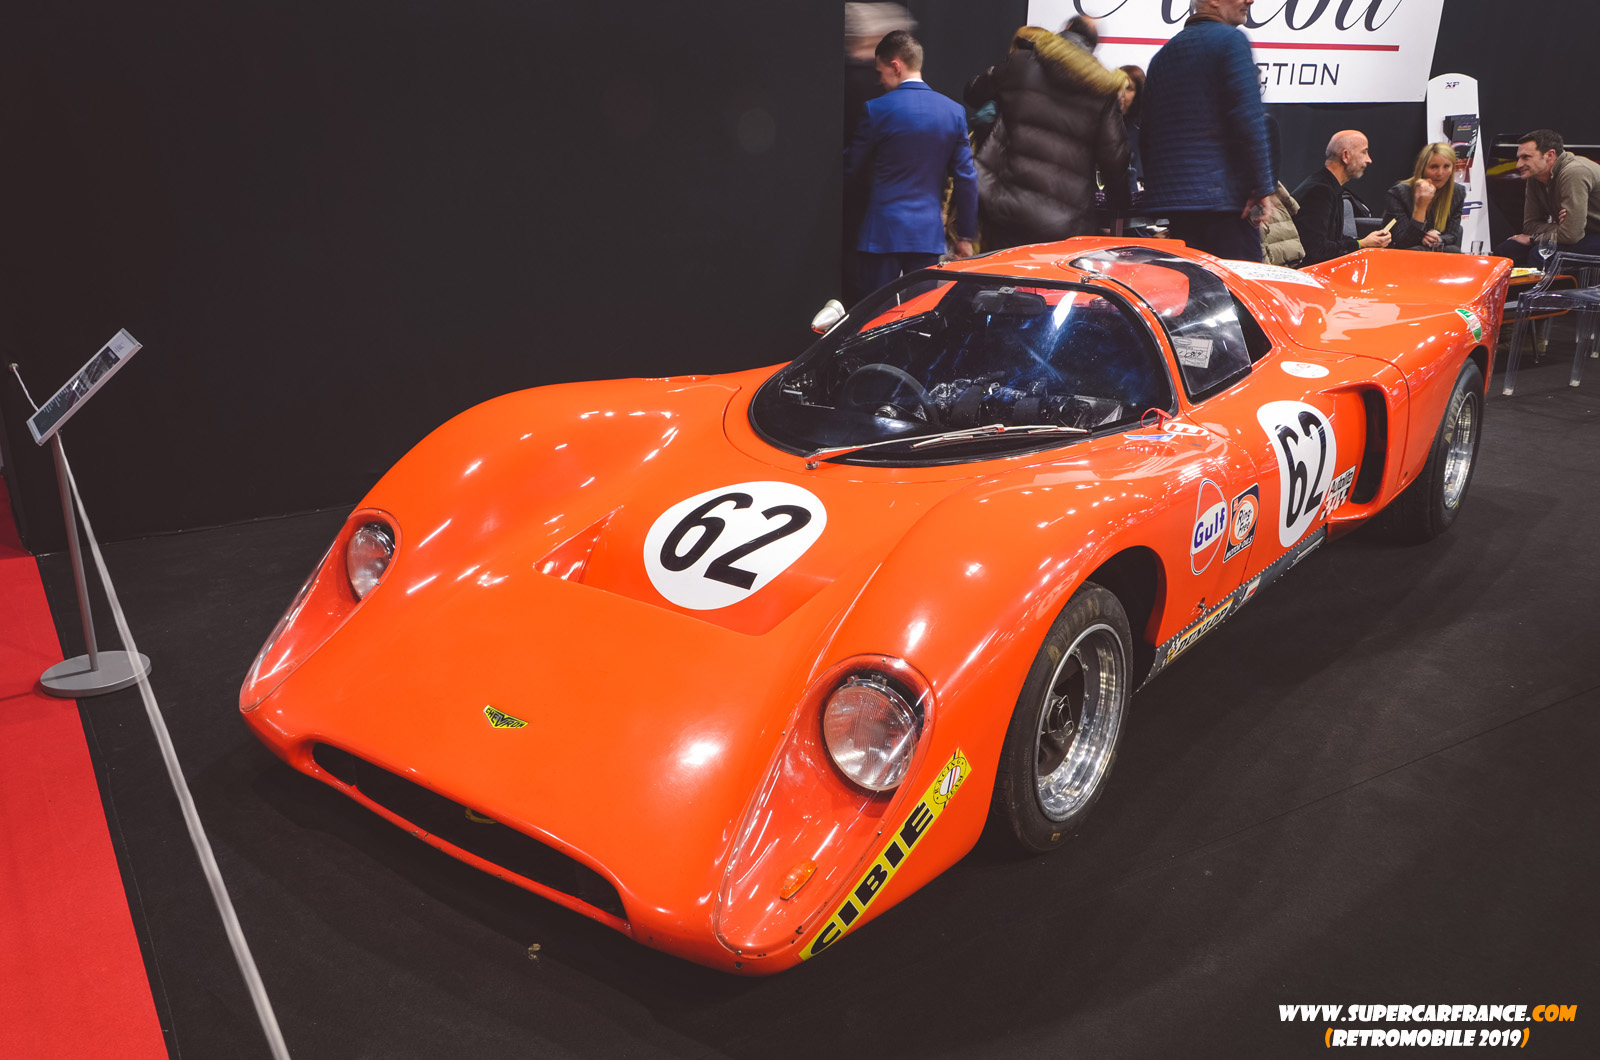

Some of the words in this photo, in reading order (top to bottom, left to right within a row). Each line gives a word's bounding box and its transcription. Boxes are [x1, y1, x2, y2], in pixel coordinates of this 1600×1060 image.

[1274, 410, 1327, 528] 62
[660, 492, 812, 590] 62
[1194, 507, 1226, 548] Gulf
[934, 758, 961, 794] RACING
[810, 801, 934, 955] CIBIE
